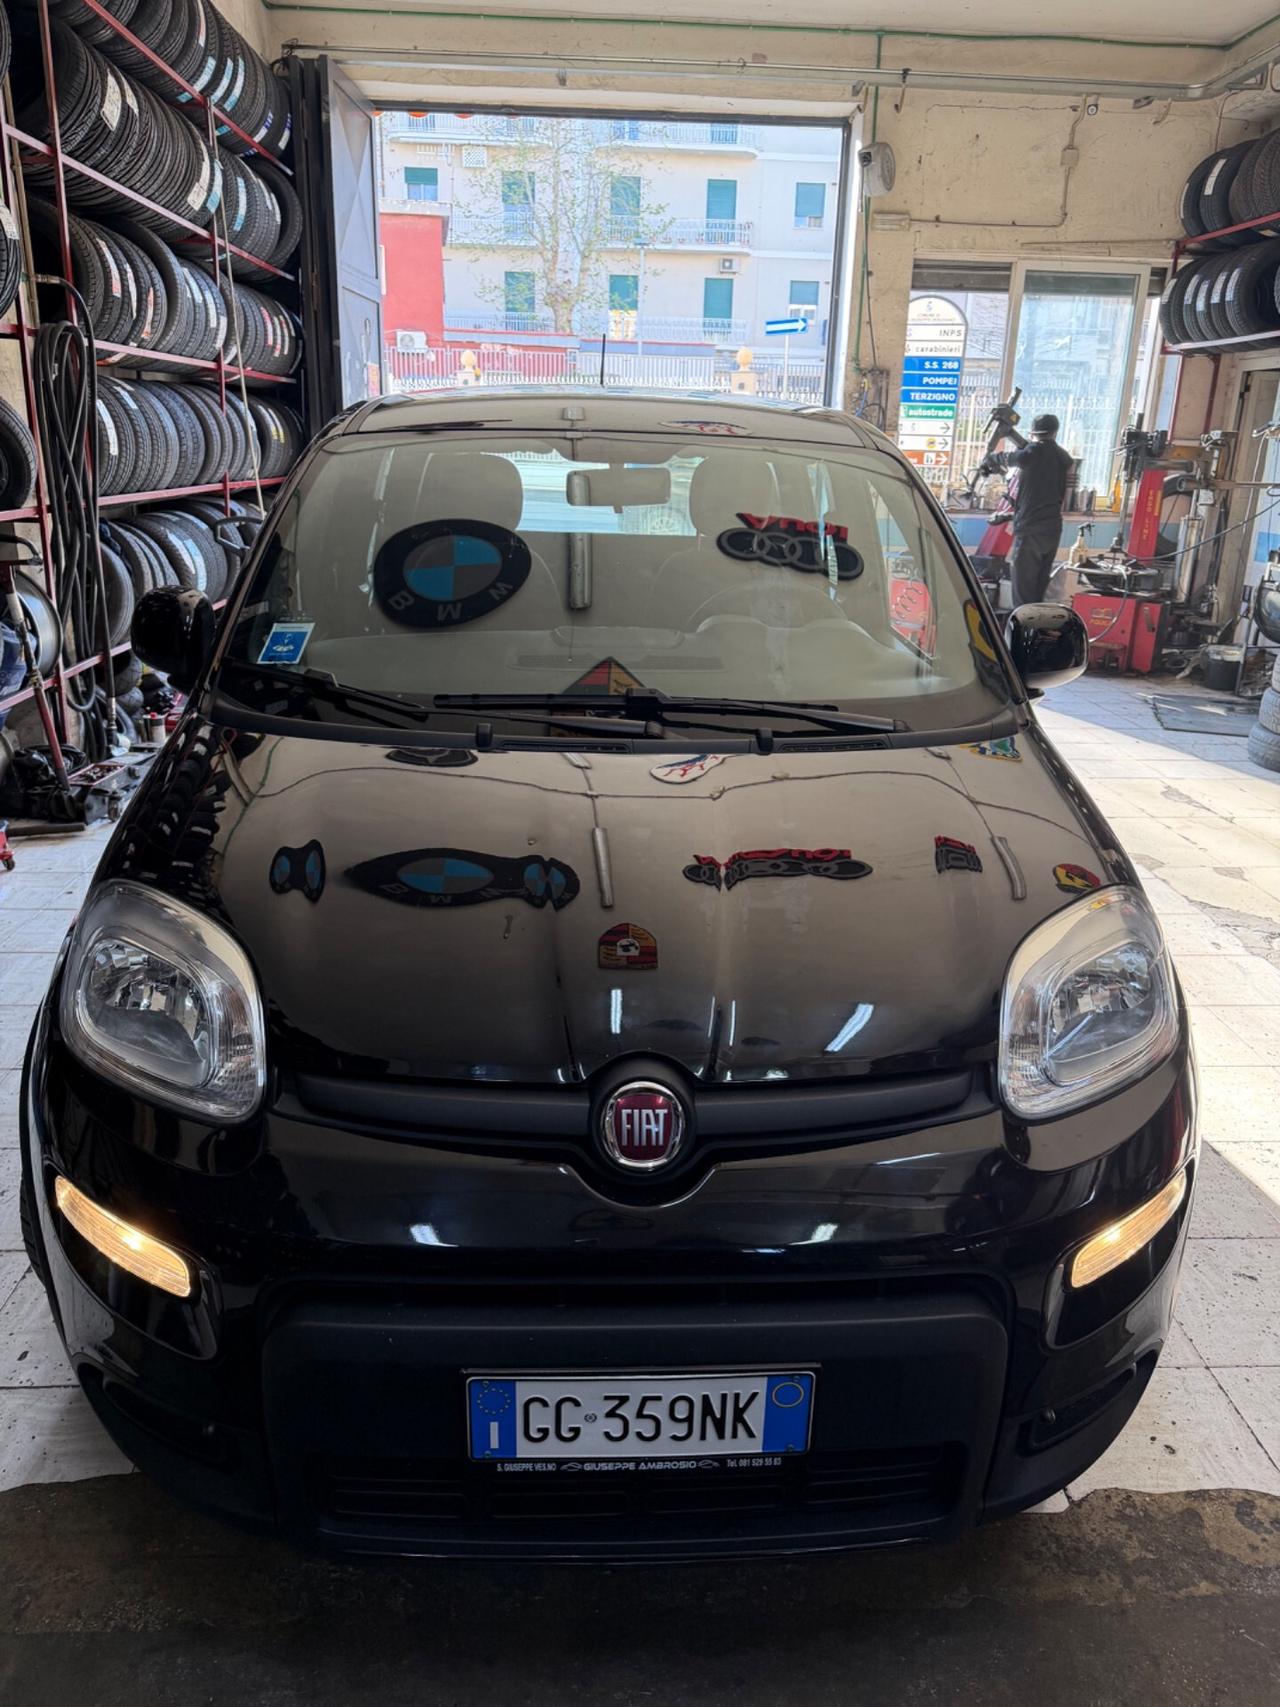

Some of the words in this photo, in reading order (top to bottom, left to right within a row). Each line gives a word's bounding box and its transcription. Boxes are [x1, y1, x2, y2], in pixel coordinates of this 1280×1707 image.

[939, 329, 962, 337] INPS
[915, 344, 961, 353] carabinieri
[922, 376, 957, 386] POMPEI
[910, 392, 956, 401] TERZIGNO
[908, 407, 953, 417] autostrade
[621, 1109, 669, 1147] FIAT
[522, 1396, 582, 1443] GG
[602, 1391, 760, 1442] 359NK
[504, 1463, 533, 1472] GIUSEPPE
[583, 1462, 636, 1471] GIUSEPPE
[638, 1461, 697, 1471] AMBROSIO
